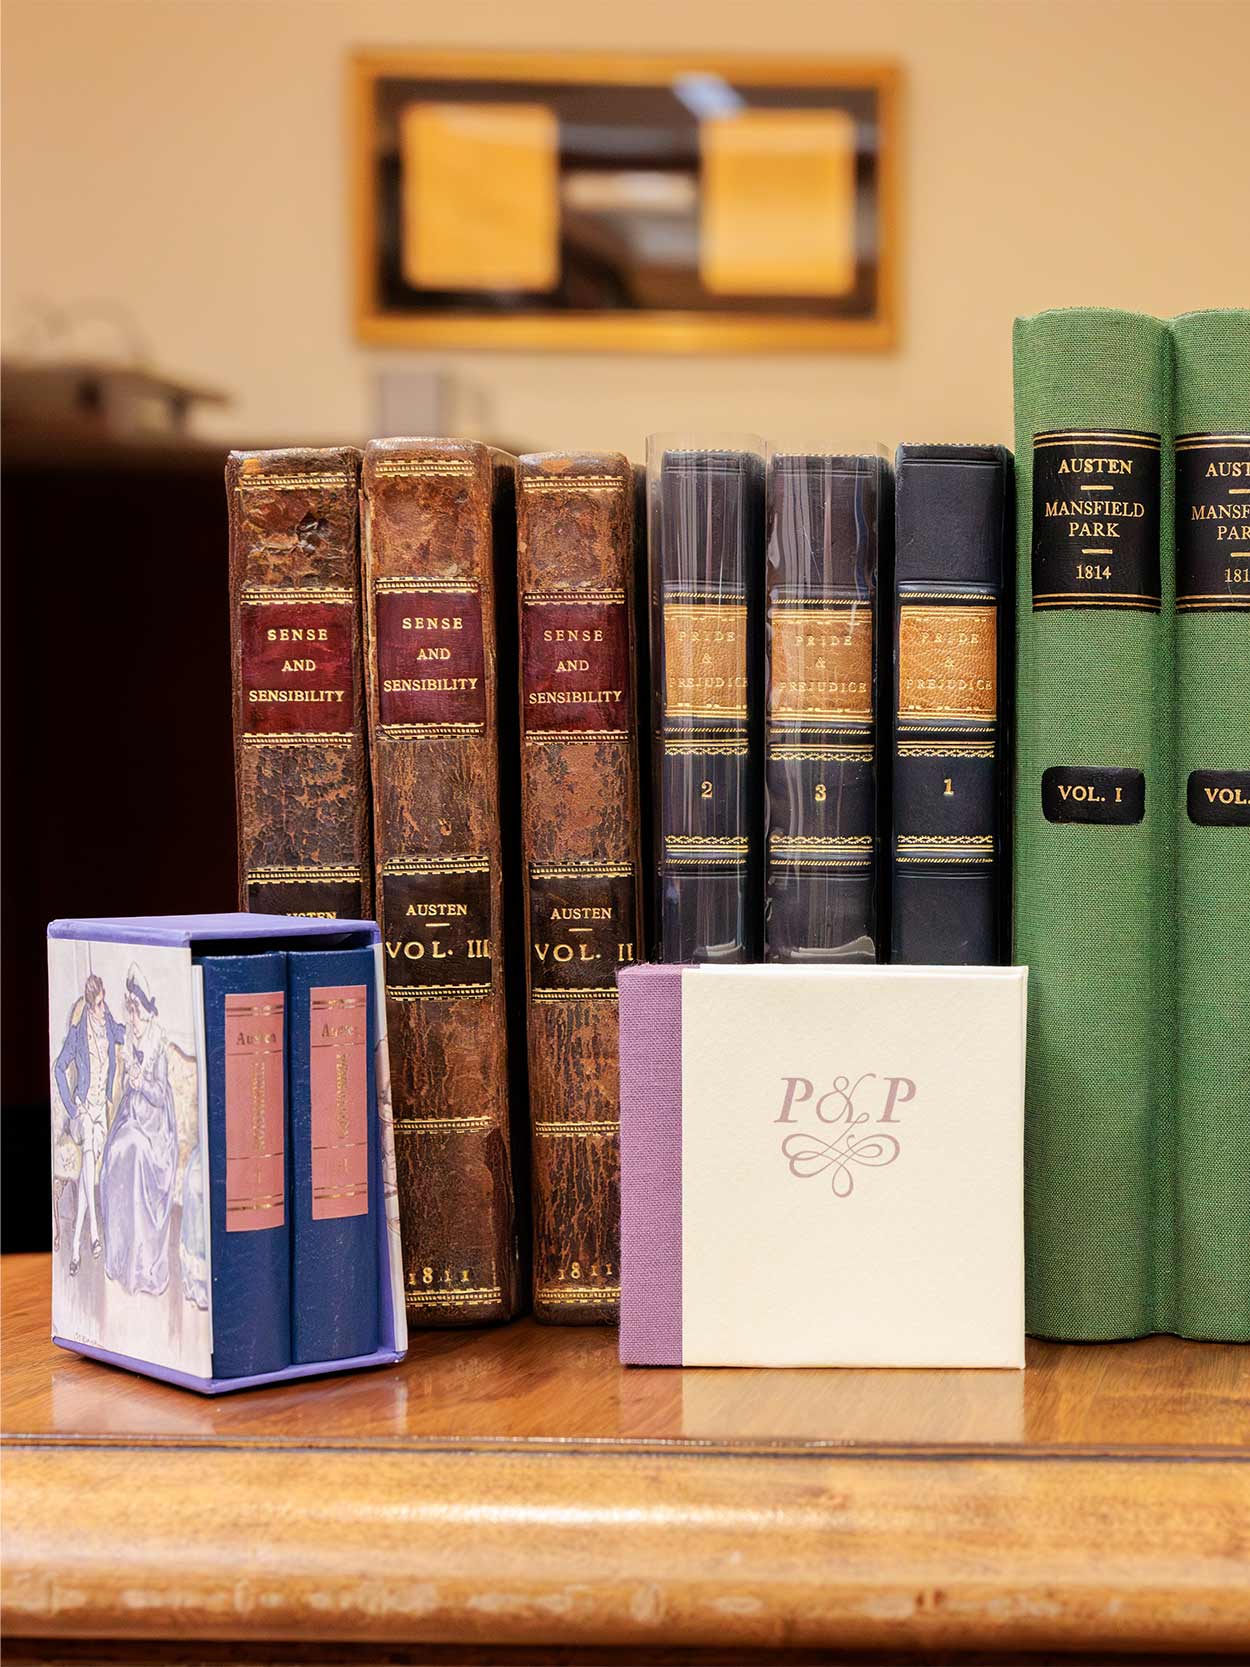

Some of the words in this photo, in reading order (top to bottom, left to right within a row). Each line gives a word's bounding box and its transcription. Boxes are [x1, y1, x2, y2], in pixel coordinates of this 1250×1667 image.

[1058, 458, 1133, 474] AUSTEN
[1045, 501, 1145, 518] MANSFIELD
[1068, 521, 1121, 537] PARK
[1075, 564, 1112, 581] 1814
[402, 617, 463, 630] SENSE
[267, 629, 328, 641] SENSE
[544, 630, 603, 642] SENSE
[677, 631, 736, 643] PRIDE
[795, 635, 852, 647] PRIDE
[920, 631, 979, 645] PRIDE
[417, 647, 451, 660] AND
[701, 653, 713, 665] &
[281, 660, 316, 672] AND
[555, 659, 590, 672] AND
[815, 656, 827, 669] &
[383, 678, 478, 692] SENSIBILITY
[779, 681, 867, 693] PREJUDICE
[905, 678, 993, 691] PREJUDICE
[249, 690, 344, 702] SENSIBILITY
[529, 690, 622, 704] SENSIBILITY
[701, 781, 713, 799] 2
[814, 784, 827, 802] 3
[943, 778, 955, 796] 1
[1058, 785, 1106, 802] VOL.
[1115, 787, 1123, 803] I
[406, 904, 467, 916] AUSTEN
[550, 906, 612, 920] AUSTEN
[385, 941, 453, 960] VOL.
[534, 943, 601, 962] VOL.
[618, 945, 633, 961] II
[409, 1267, 470, 1285] 1811
[558, 1262, 612, 1280] 1811
